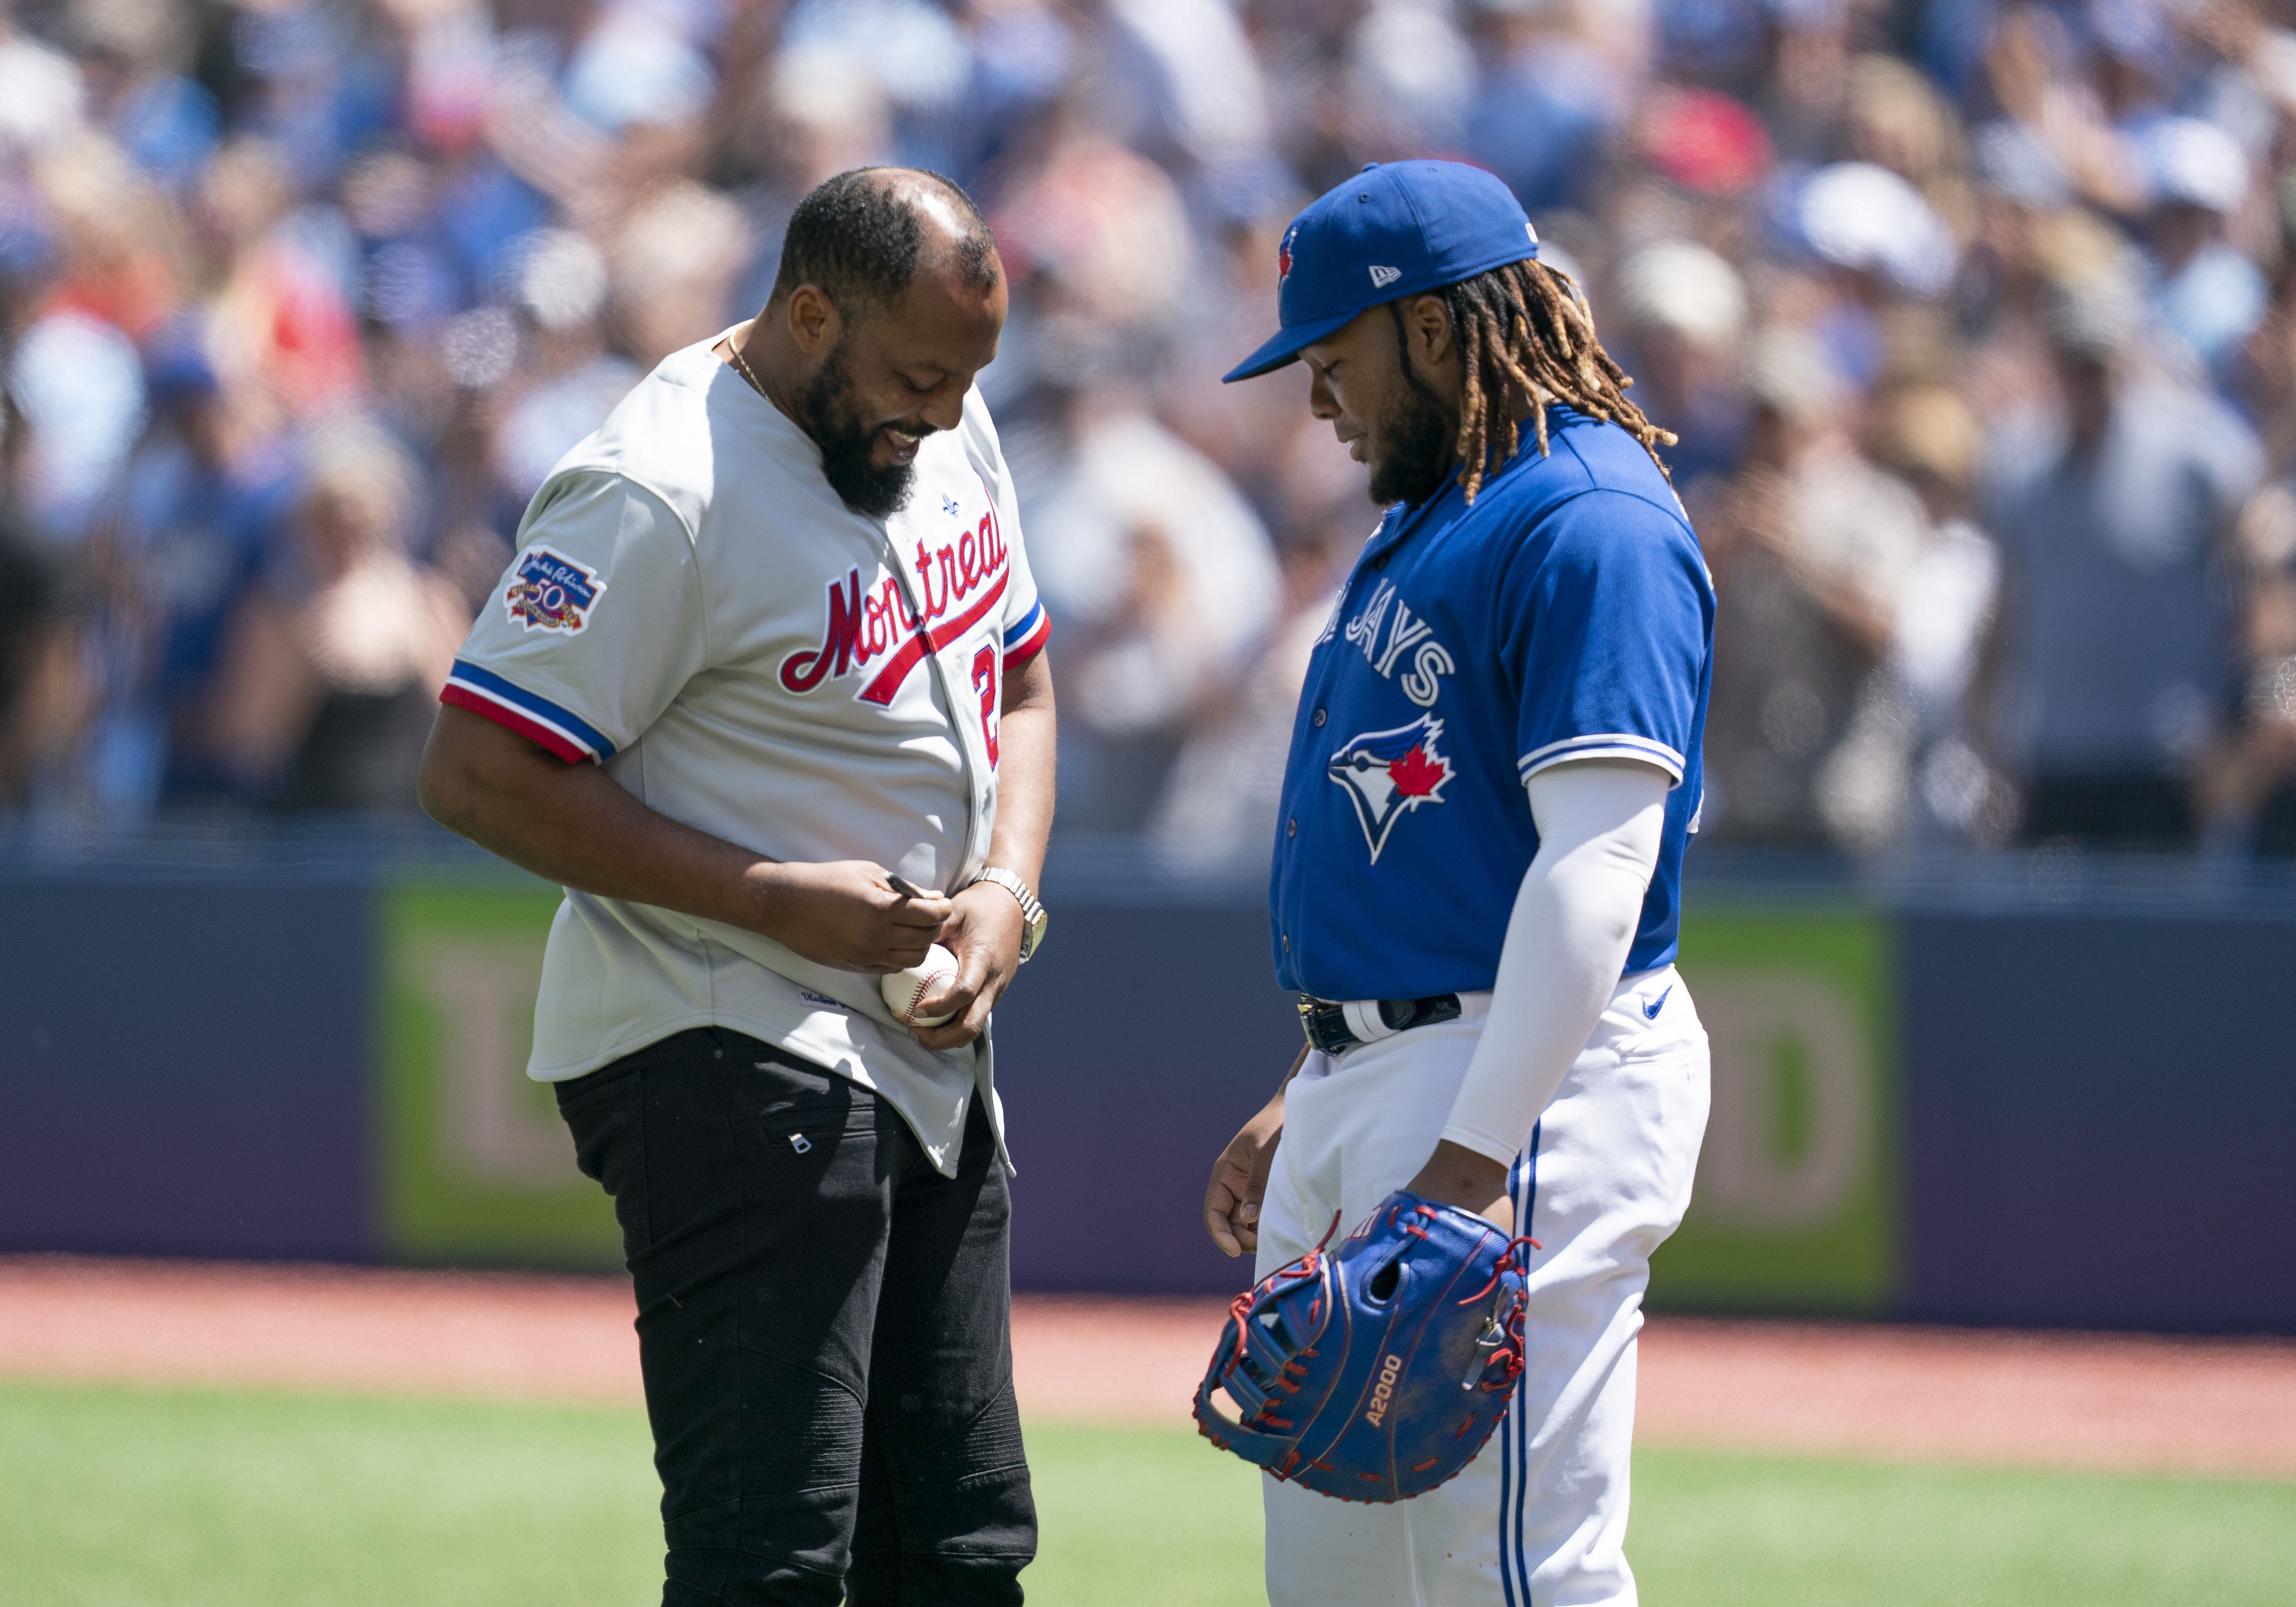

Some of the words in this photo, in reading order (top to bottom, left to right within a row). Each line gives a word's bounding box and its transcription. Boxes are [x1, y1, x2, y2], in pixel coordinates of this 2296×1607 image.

[526, 577, 566, 611] 50
[779, 483, 1008, 692] Montreal
[1345, 576, 1455, 708] JAYS
[970, 643, 999, 773] 2
[1365, 1353, 1403, 1429] A2000
